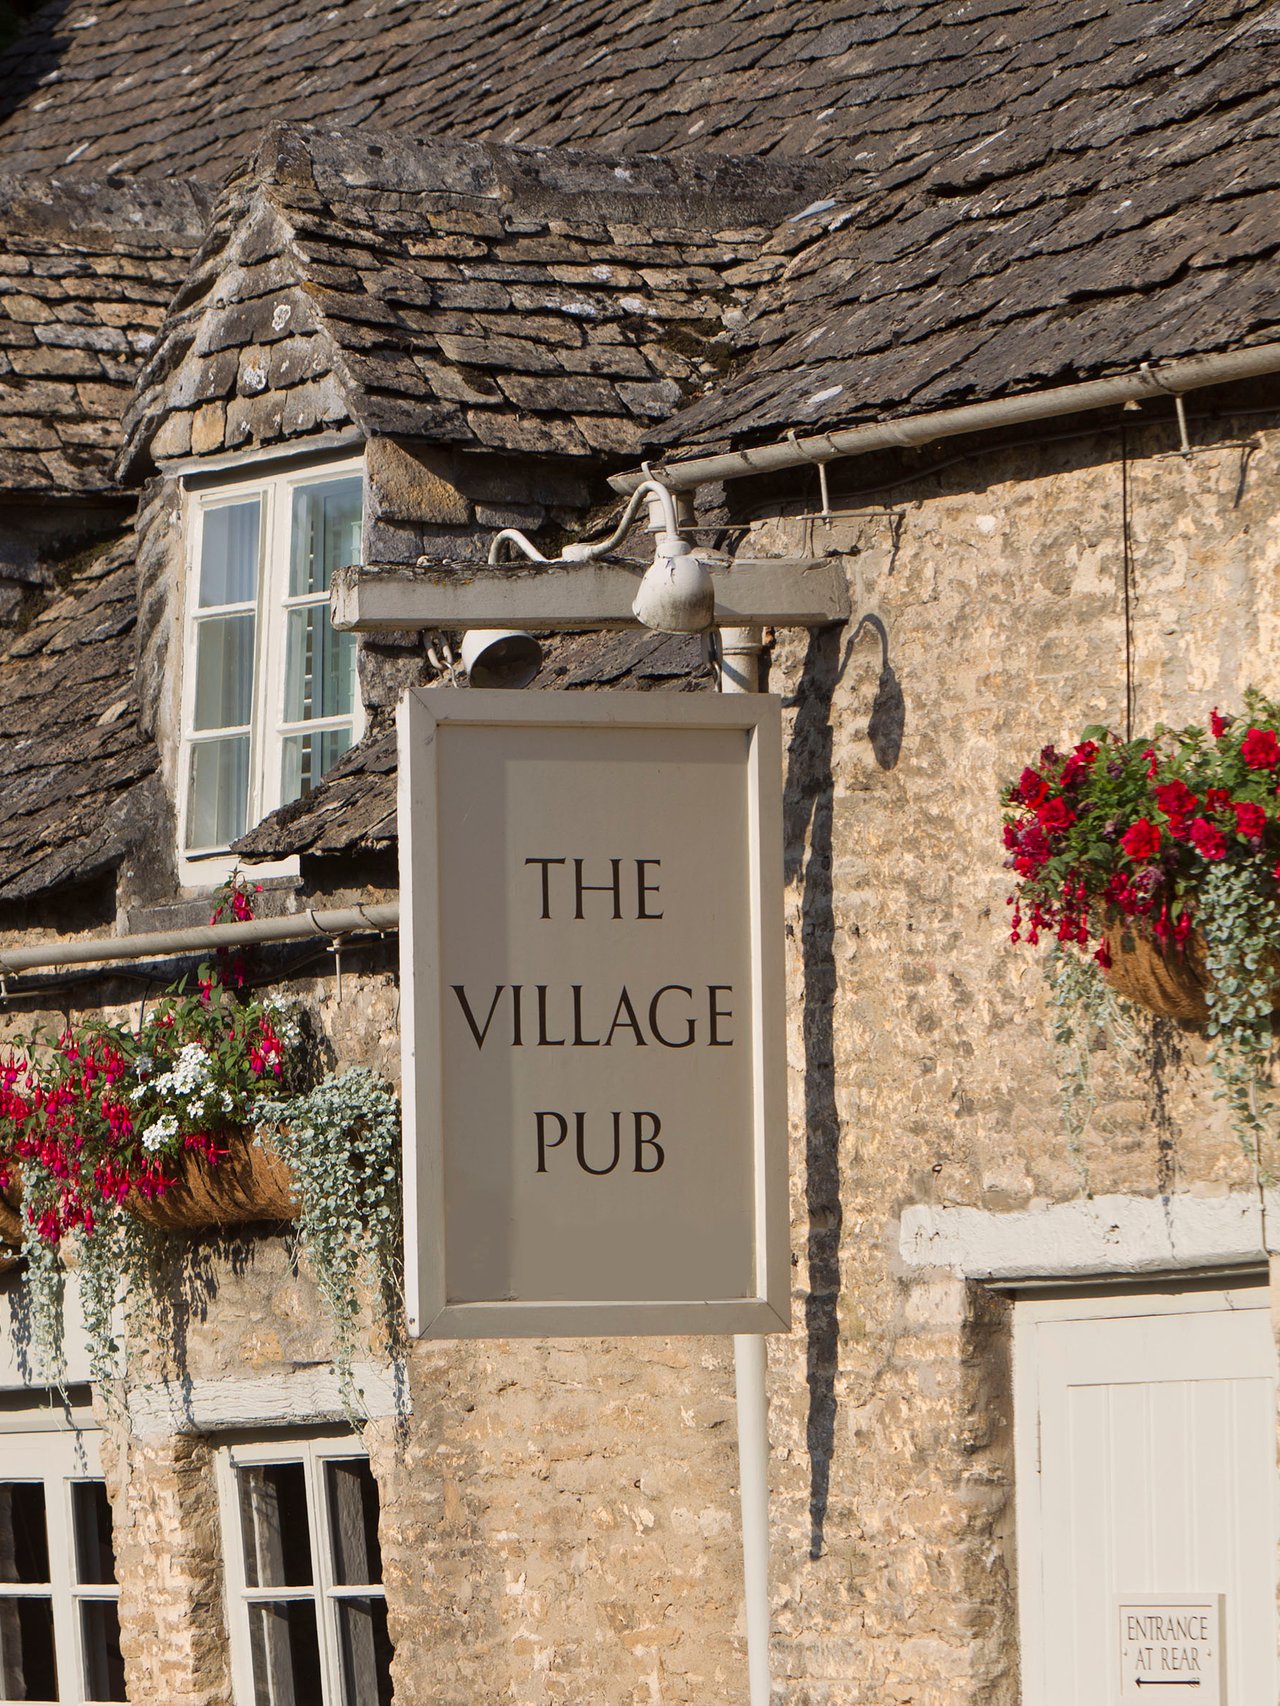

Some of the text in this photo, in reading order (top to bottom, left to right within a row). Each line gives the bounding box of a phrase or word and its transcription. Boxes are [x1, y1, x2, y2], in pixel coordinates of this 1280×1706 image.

[524, 857, 664, 920] THE
[448, 984, 735, 1052] VILLAGE
[533, 1110, 666, 1176] PUB
[1127, 1615, 1208, 1641] ENTRANCE
[1135, 1646, 1202, 1671] AT REAR
